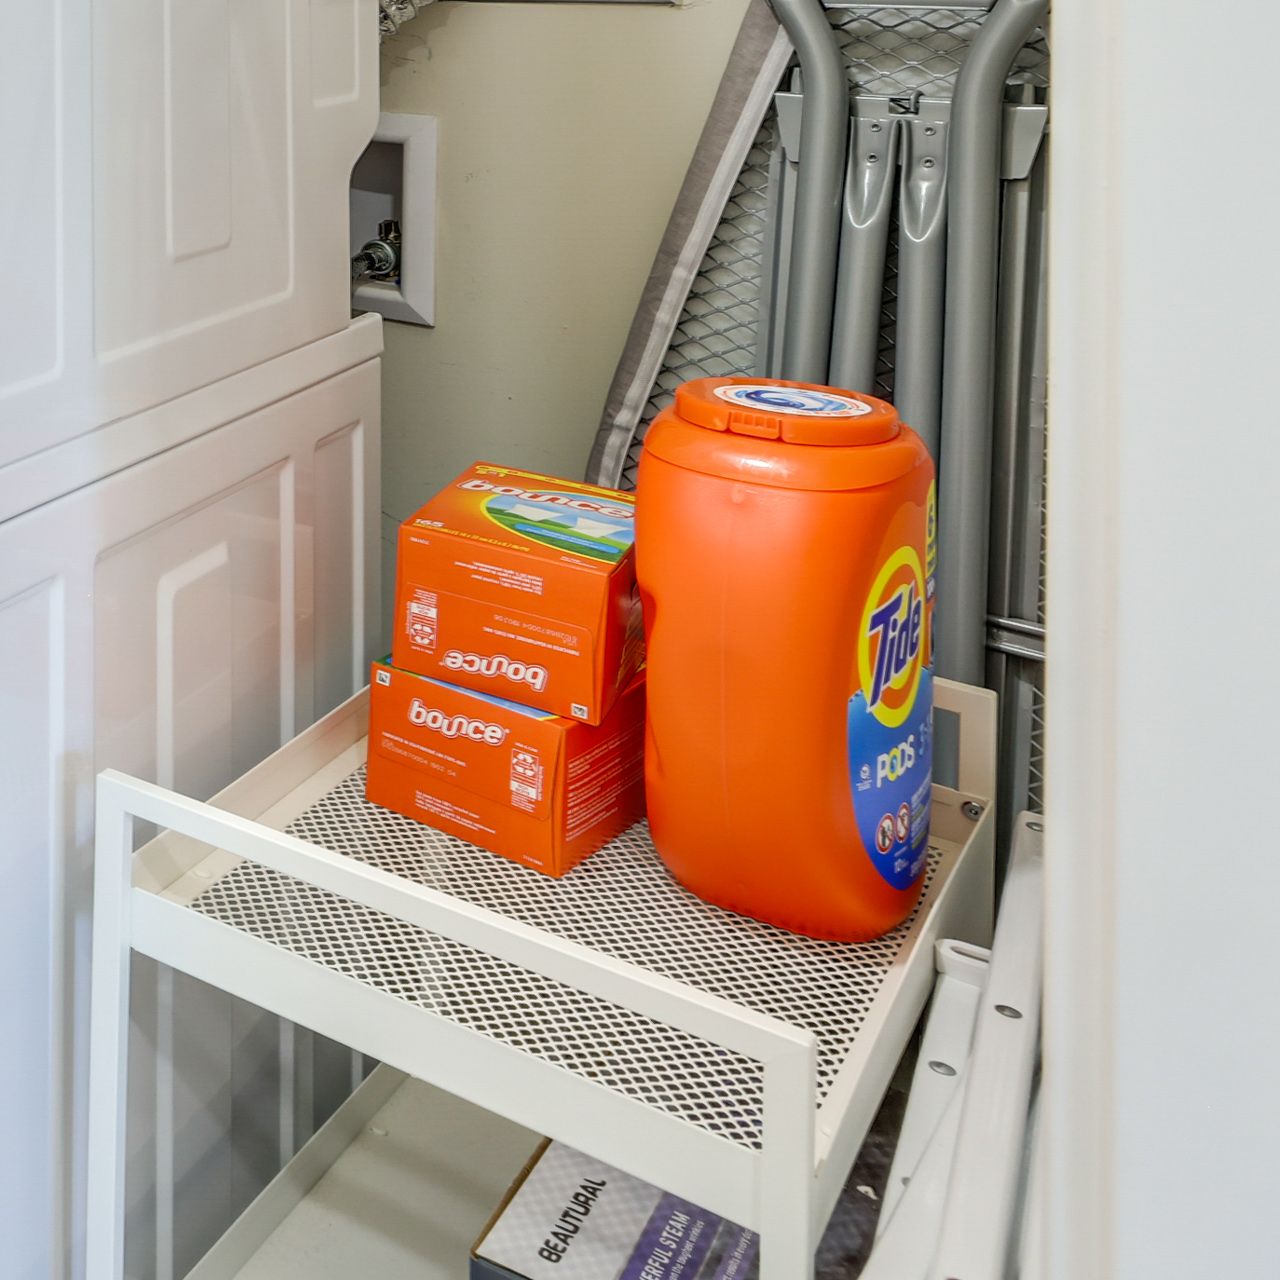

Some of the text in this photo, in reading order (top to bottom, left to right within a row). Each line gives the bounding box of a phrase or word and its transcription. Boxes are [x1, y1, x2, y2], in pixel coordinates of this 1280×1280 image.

[457, 479, 635, 519] bounce
[443, 650, 548, 691] bounce
[866, 580, 922, 713] Tide
[408, 698, 507, 746] bounce
[876, 734, 916, 788] PODS
[538, 1178, 607, 1264] BEAUTURAL
[639, 1210, 691, 1280] ERFUL STEAM
[678, 1240, 696, 1266] toughest
